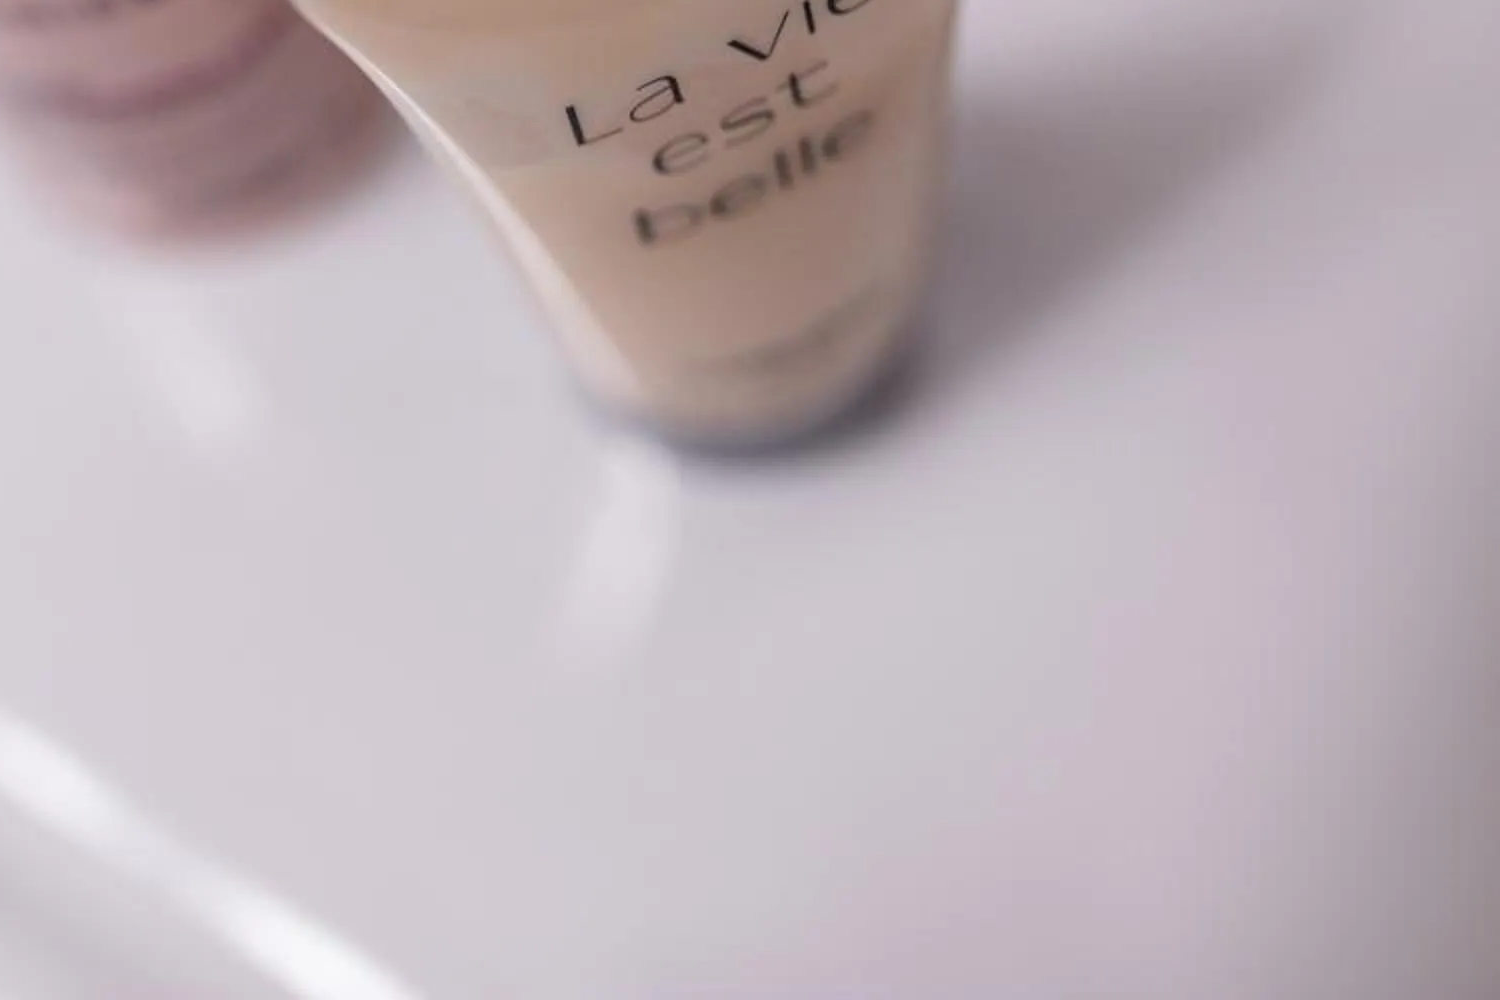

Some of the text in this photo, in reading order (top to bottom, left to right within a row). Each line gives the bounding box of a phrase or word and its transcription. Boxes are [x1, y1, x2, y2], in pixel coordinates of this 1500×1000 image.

[565, 75, 684, 146] La
[652, 60, 837, 176] est
[633, 109, 876, 245] belle
